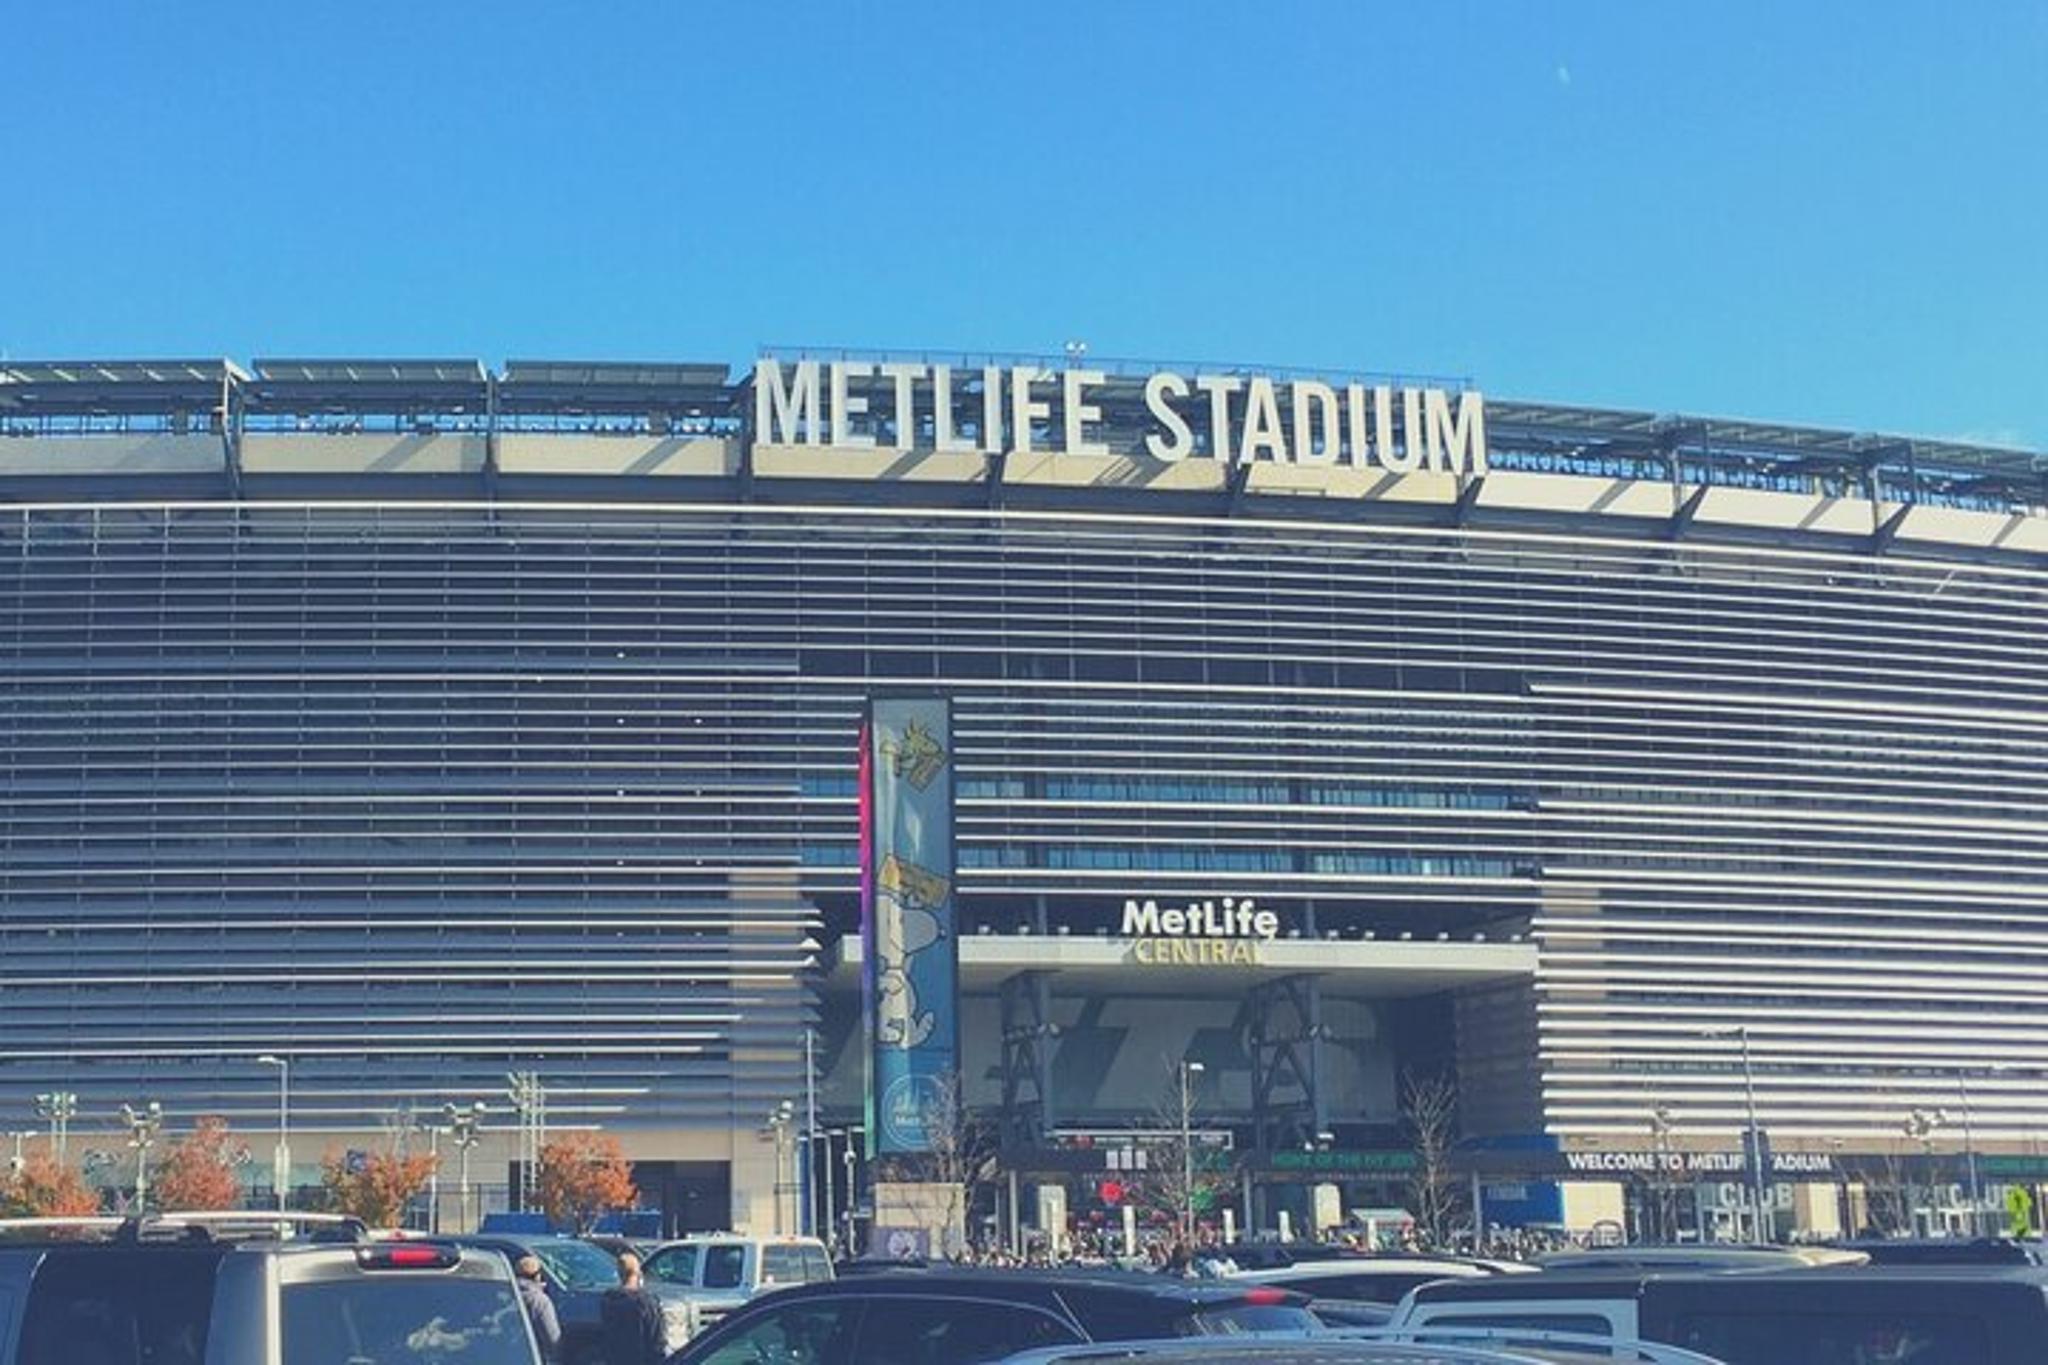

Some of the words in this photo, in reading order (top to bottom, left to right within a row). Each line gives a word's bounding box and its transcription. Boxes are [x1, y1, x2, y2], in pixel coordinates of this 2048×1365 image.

[754, 358, 1110, 454] METLIFE
[1144, 371, 1488, 478] STADIUM
[1121, 897, 1279, 937] MetLife
[1566, 1152, 1656, 1170] WELCOME
[1658, 1152, 1683, 1170] TO
[1689, 1153, 1745, 1171] METLIF
[1771, 1153, 1831, 1171] ADIUM
[1719, 1181, 1793, 1208] CLUB
